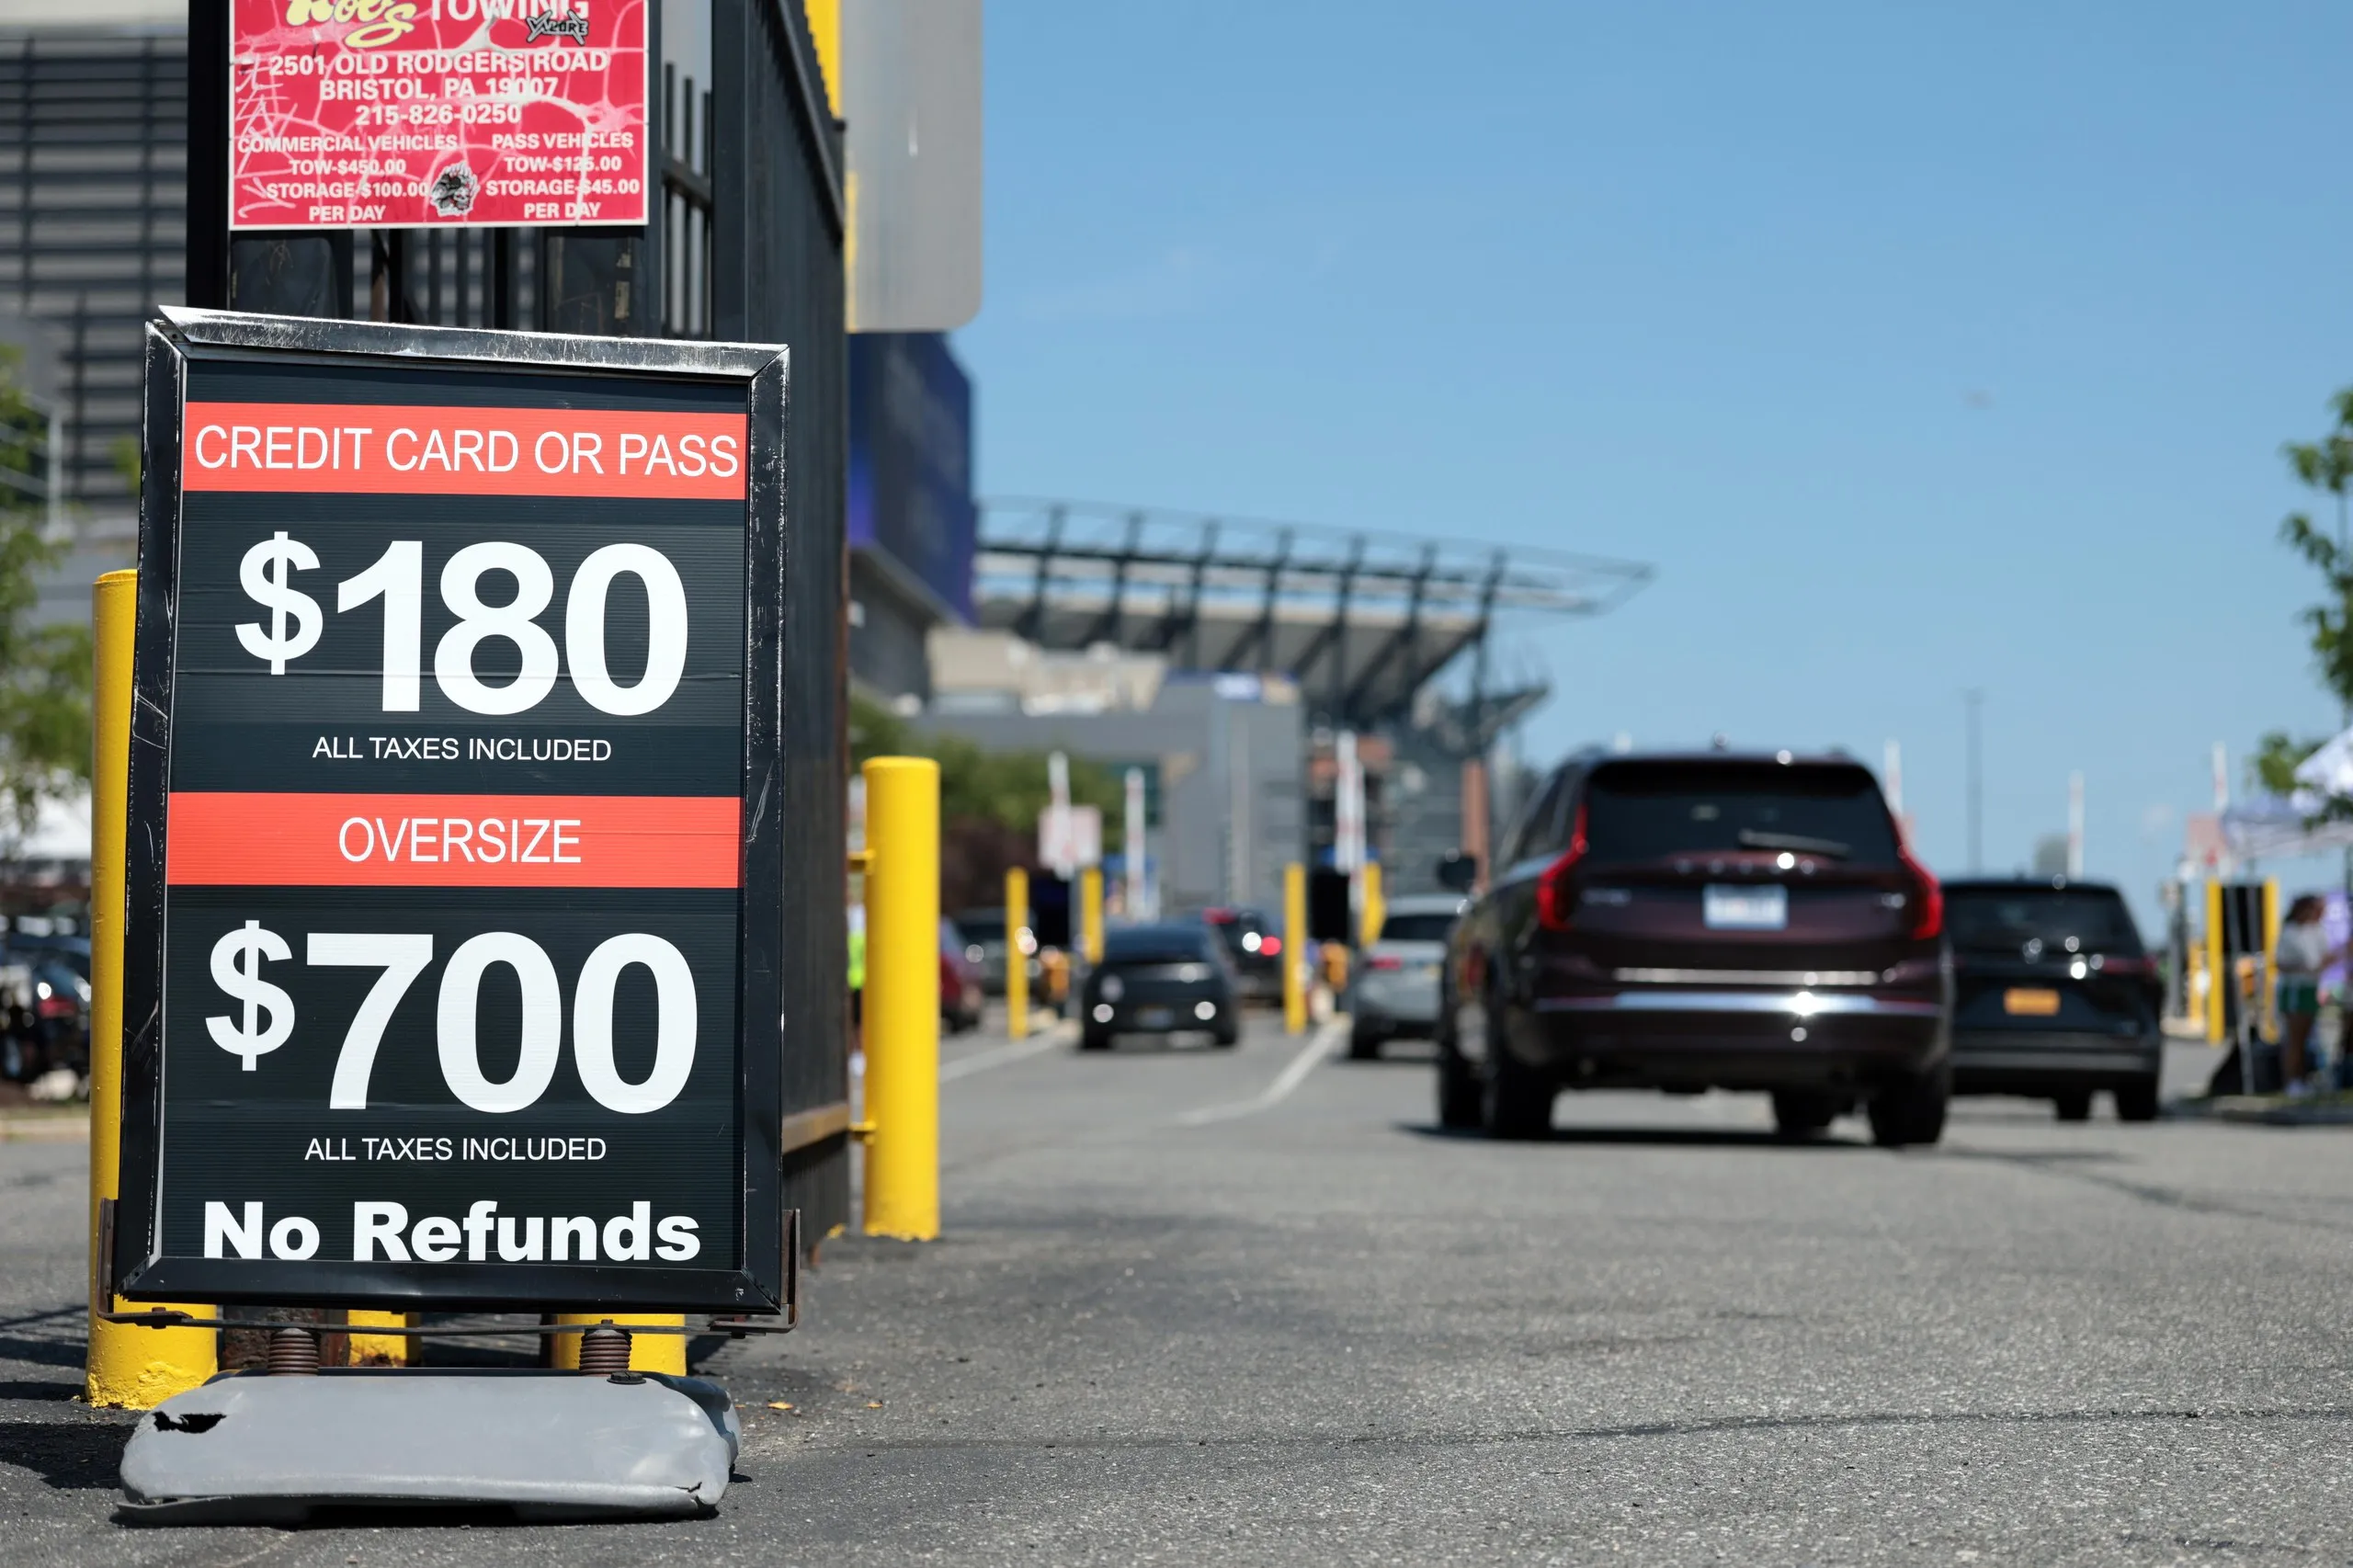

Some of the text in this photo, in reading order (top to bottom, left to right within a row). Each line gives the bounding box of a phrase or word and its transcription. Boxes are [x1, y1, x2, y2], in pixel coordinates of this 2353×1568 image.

[270, 51, 608, 75] 2501 OLD RODGERS ROAD
[320, 77, 558, 101] BRISTOL, PA 19007
[356, 104, 521, 126] 215-826-0250
[238, 134, 458, 153] COMMERCIAL VEHICLES
[492, 132, 633, 149] PASS VEHICLES
[289, 159, 406, 176] TOW-$450.00
[309, 205, 386, 222] PER DAY
[524, 201, 601, 219] PER DAY
[196, 426, 737, 477] CREDIT CARD OR PASS
[235, 532, 688, 715] $180
[313, 737, 610, 760] ALL TAXES INCLUDED
[339, 817, 581, 862] OVERSIZE
[206, 921, 697, 1113] $700
[305, 1139, 606, 1160] ALL TAXES INCLUDED
[205, 1201, 699, 1261] No Refunds
